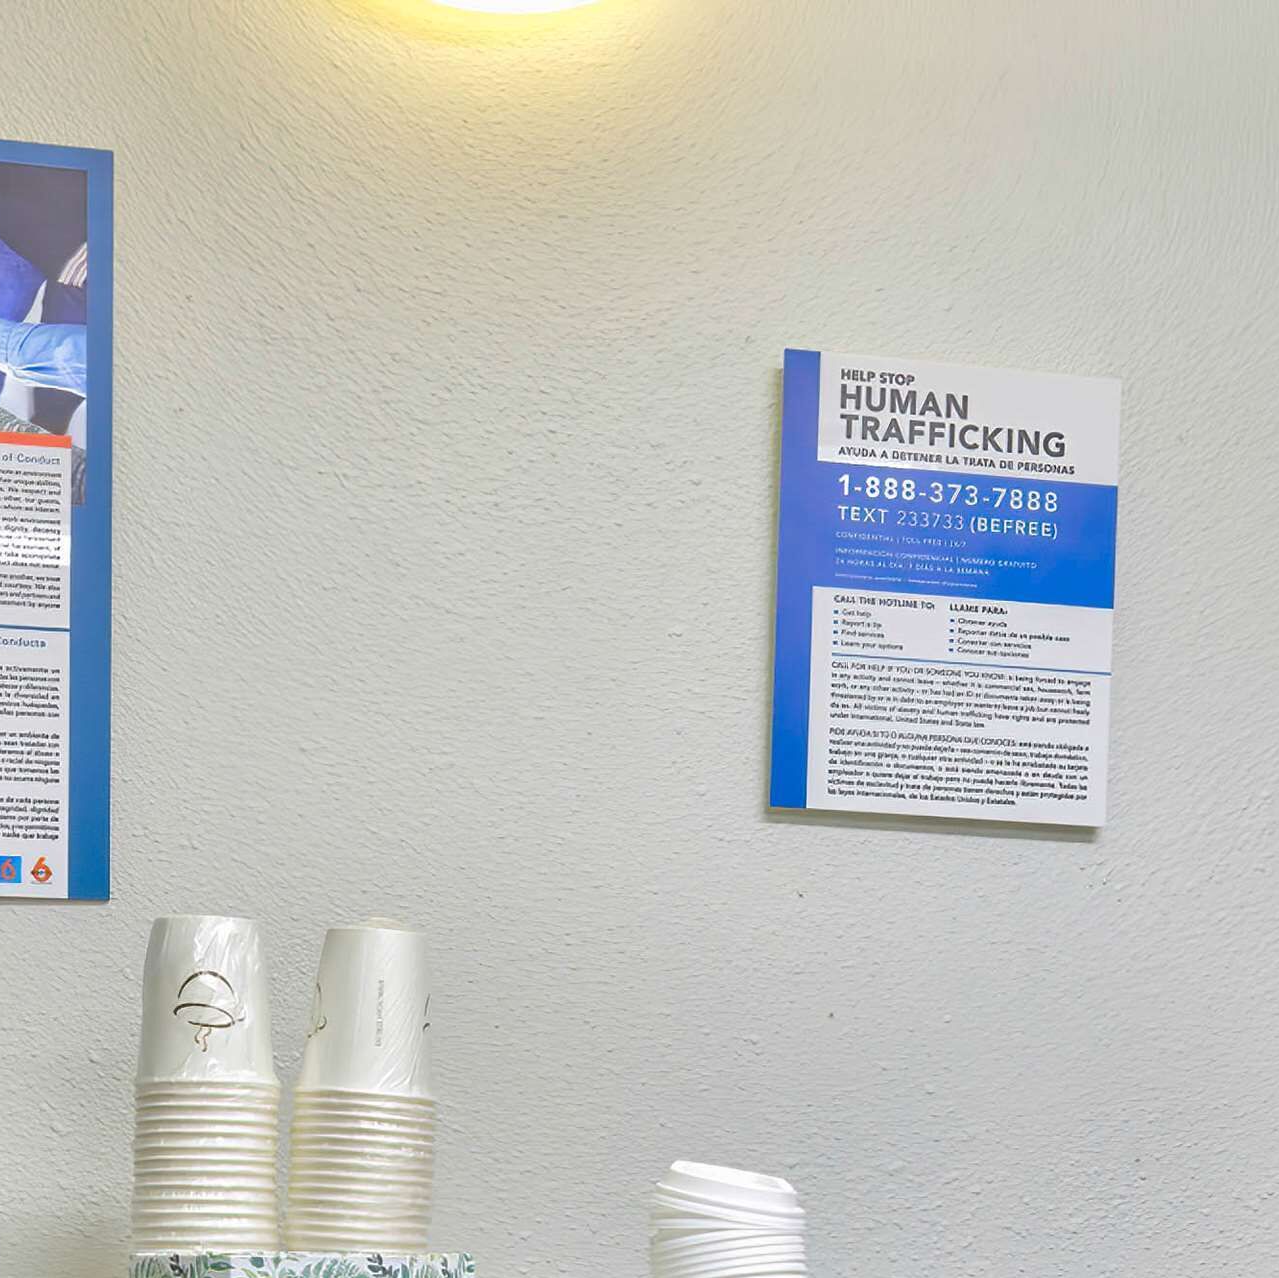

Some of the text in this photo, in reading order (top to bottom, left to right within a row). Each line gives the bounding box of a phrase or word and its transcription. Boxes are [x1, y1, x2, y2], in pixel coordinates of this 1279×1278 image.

[839, 368, 914, 386] HELP STOP
[840, 384, 968, 420] HUMAN
[840, 414, 1065, 458] TRAFFICKING
[1, 452, 12, 461] of
[16, 453, 60, 465] Conduct
[838, 446, 1074, 475] AYUDA A DETENER LA TRATA DE PERSONAS
[838, 473, 1057, 513] 1-888-373-7888
[838, 505, 1057, 539] TEXT 233733 (BEFREE)
[833, 594, 856, 605] CALL
[859, 596, 875, 606] THE
[879, 597, 917, 609] HOTLINE
[949, 602, 979, 613] LLAME
